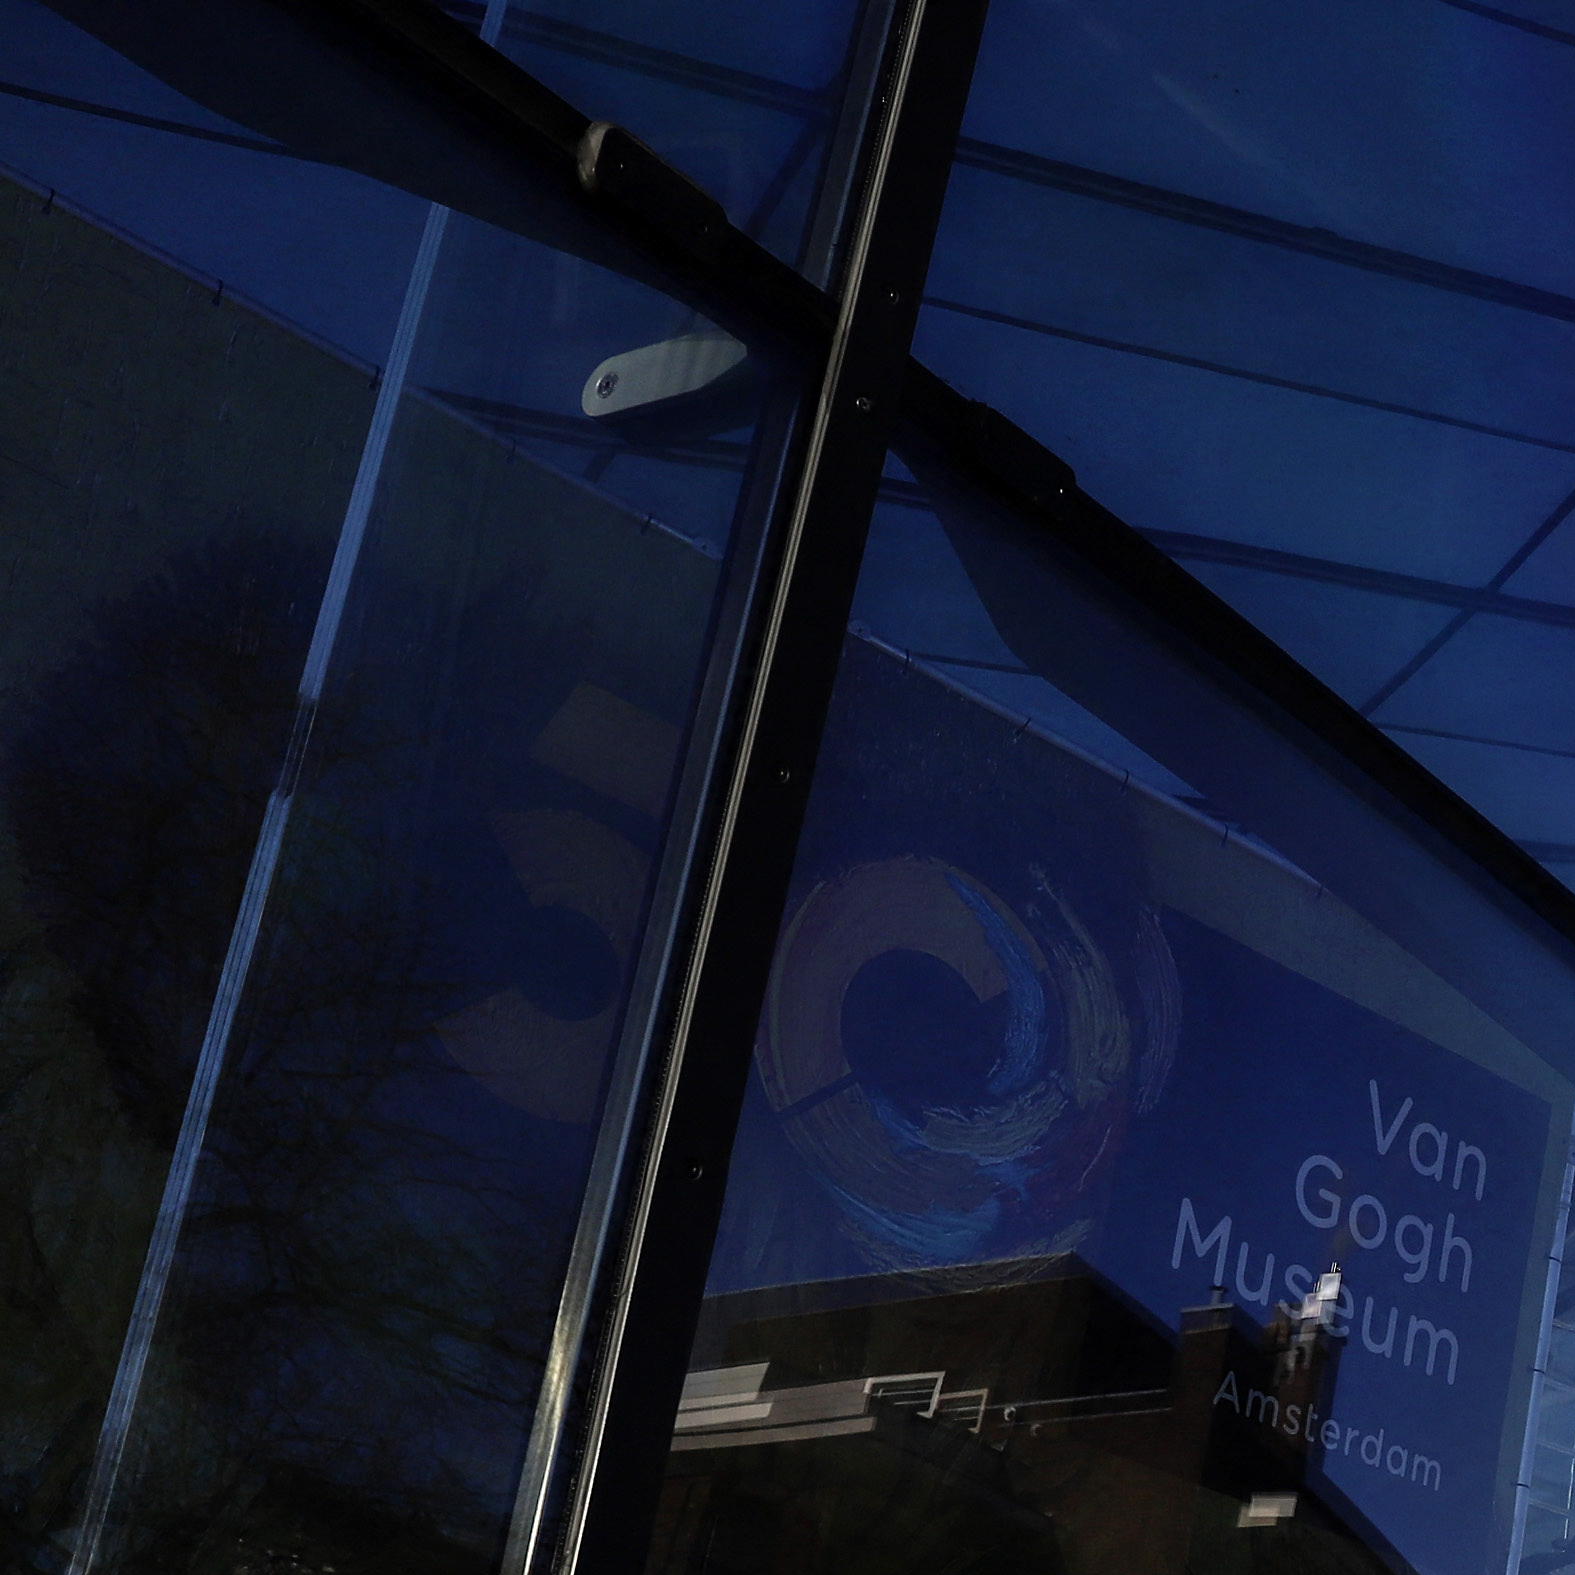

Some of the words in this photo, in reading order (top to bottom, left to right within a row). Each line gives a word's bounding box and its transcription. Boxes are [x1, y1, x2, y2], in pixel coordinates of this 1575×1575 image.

[1369, 1079, 1488, 1202] Van
[1296, 1154, 1473, 1292] Gogh
[1171, 1198, 1460, 1385] Museum
[1212, 1369, 1442, 1492] Amsterdam
